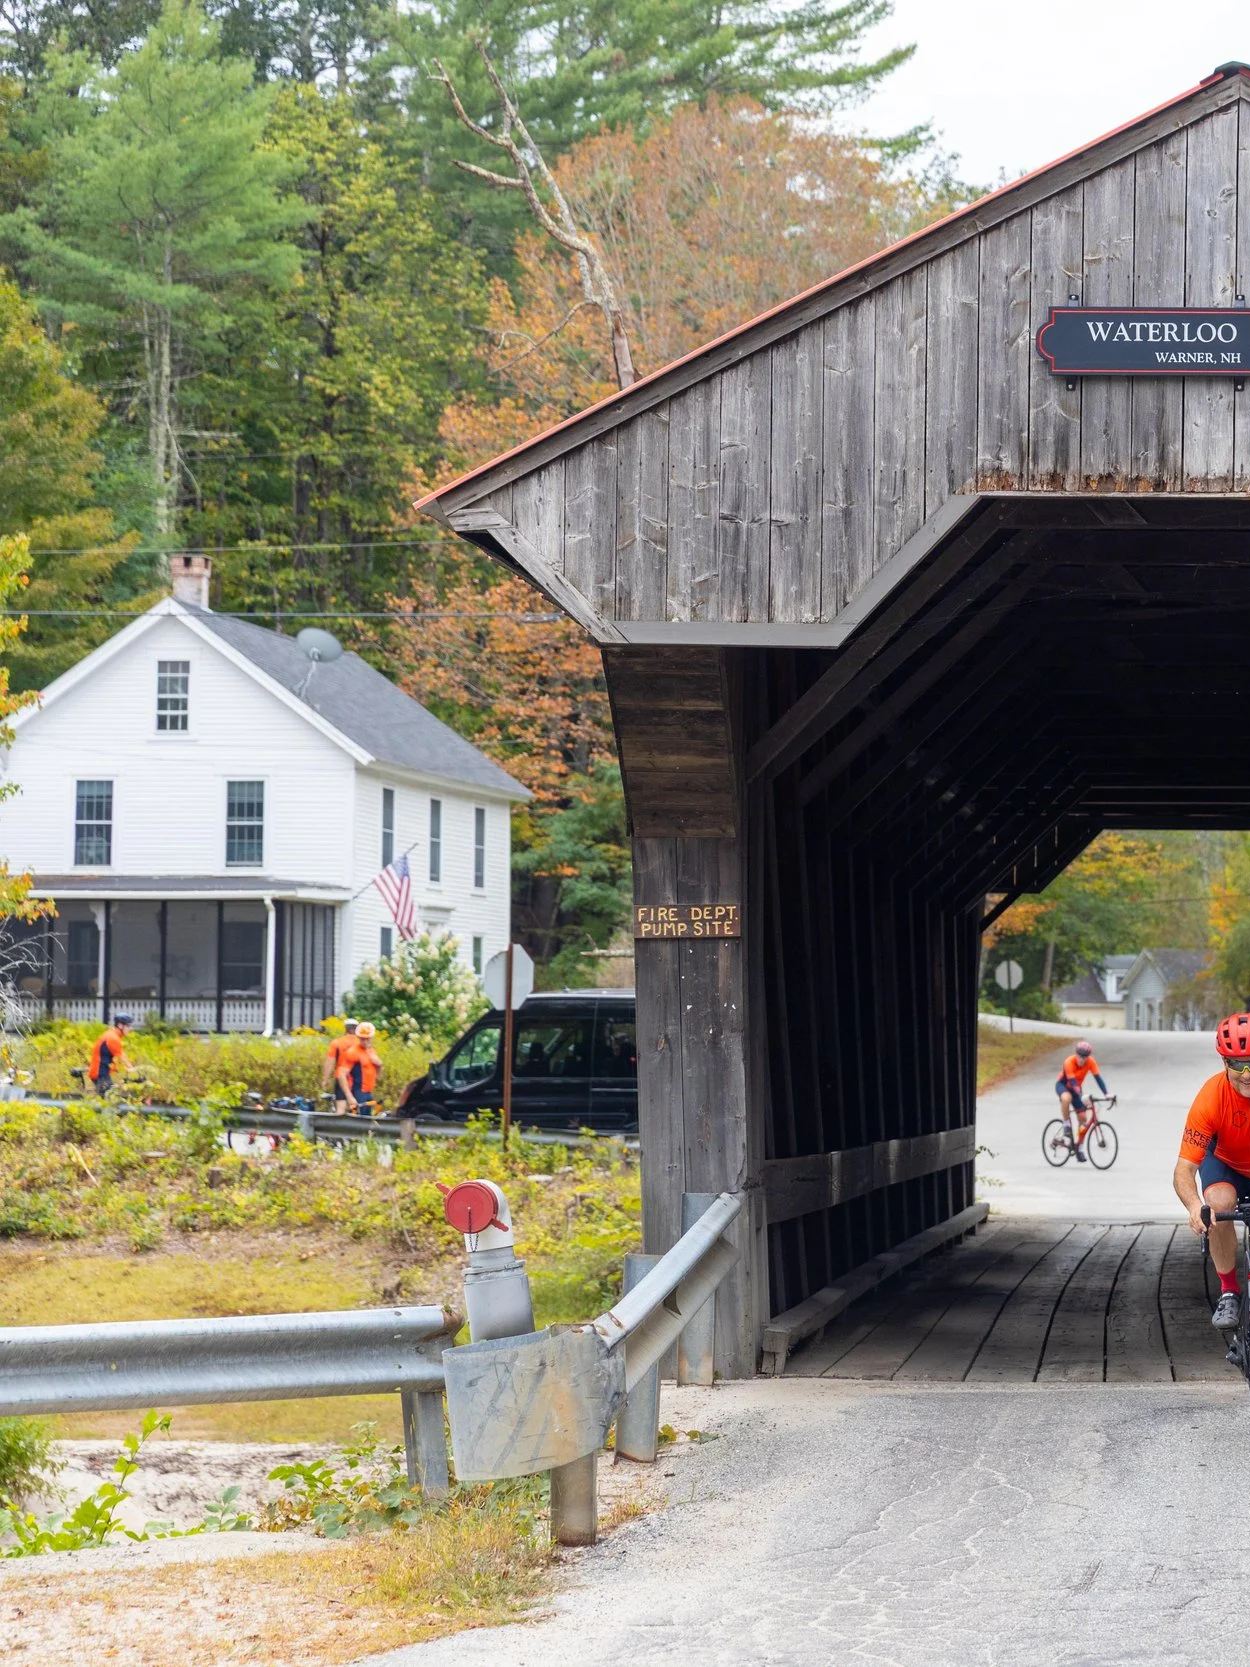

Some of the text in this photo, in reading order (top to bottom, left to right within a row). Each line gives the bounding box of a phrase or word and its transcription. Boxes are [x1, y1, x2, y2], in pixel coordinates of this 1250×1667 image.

[1086, 321, 1238, 343] WATERLOO
[1155, 352, 1217, 364] WARNER,
[1220, 352, 1241, 364] NH
[638, 906, 738, 922] FIRE DEPT.
[641, 921, 734, 937] PUMP SITE
